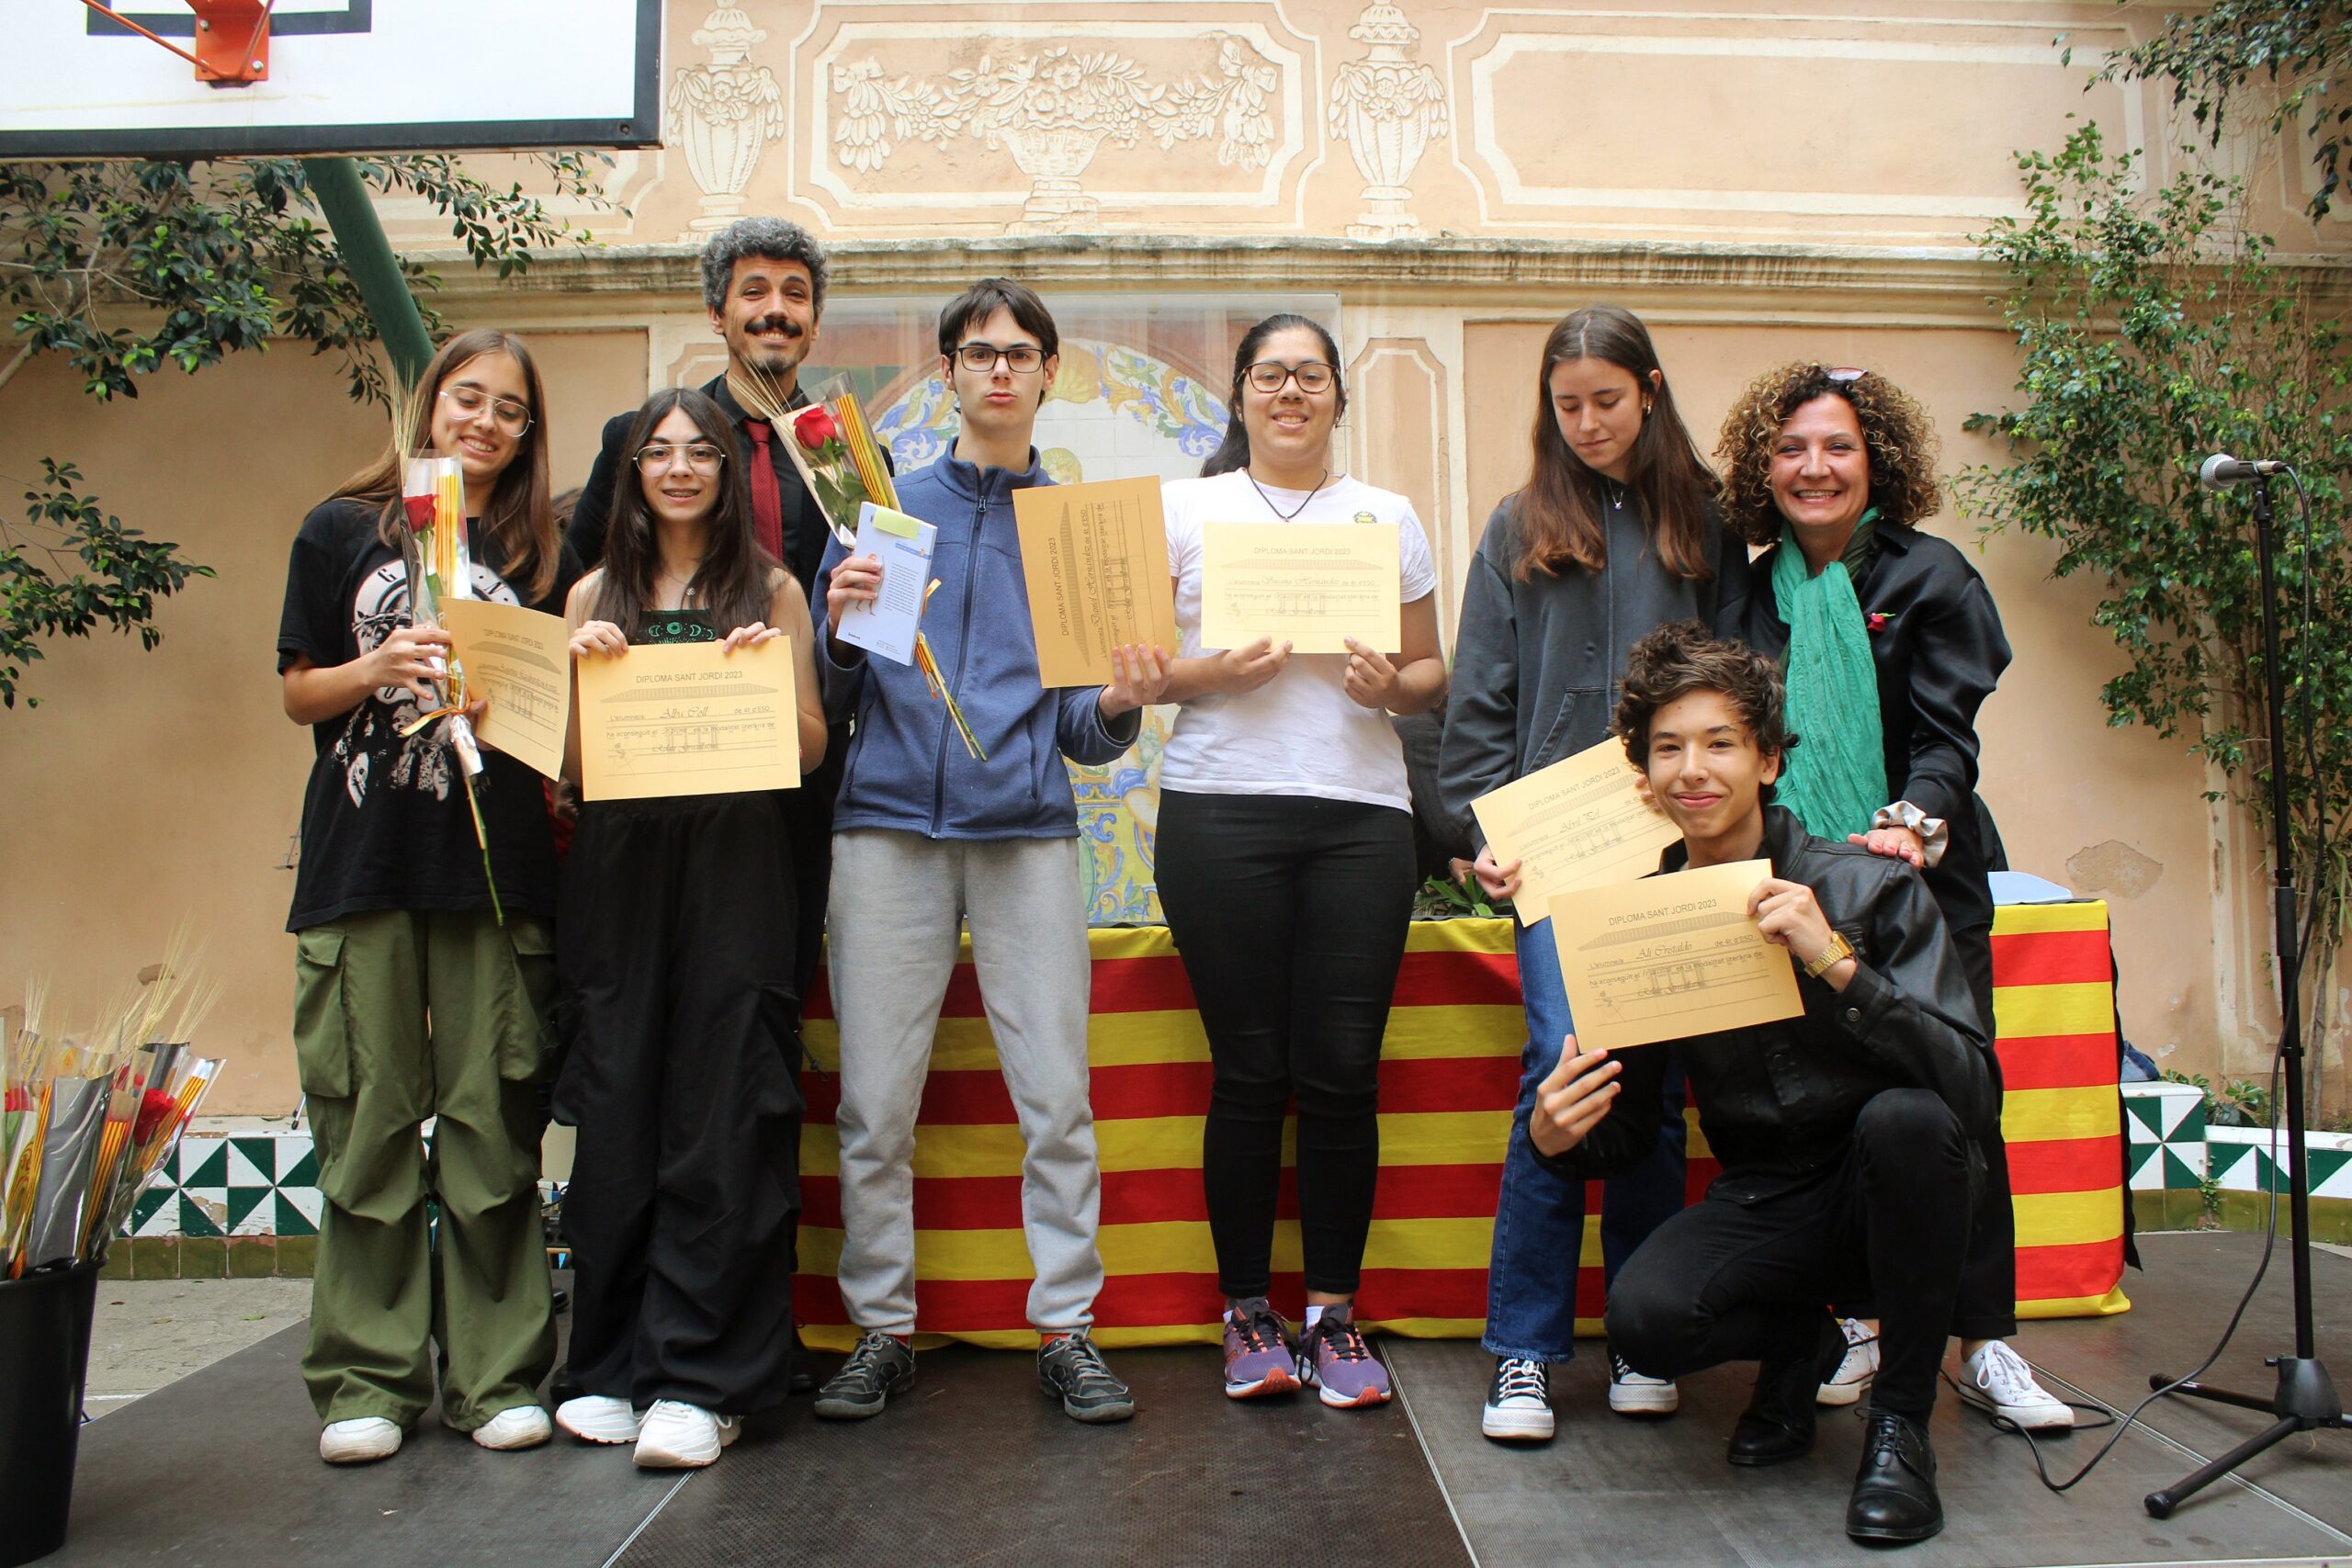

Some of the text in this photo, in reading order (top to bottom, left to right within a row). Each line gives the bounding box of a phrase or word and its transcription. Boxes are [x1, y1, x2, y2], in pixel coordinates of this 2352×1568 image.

[1047, 536, 1069, 636] DIPLOMA SANT JORDI 2023
[636, 671, 742, 683] DIPLOMA SANT JORDI 2023
[1528, 766, 1620, 809] DIPLOMA SANT JORDI 2023
[1608, 898, 1717, 926] DIPLOMA SANT JORDI 2023
